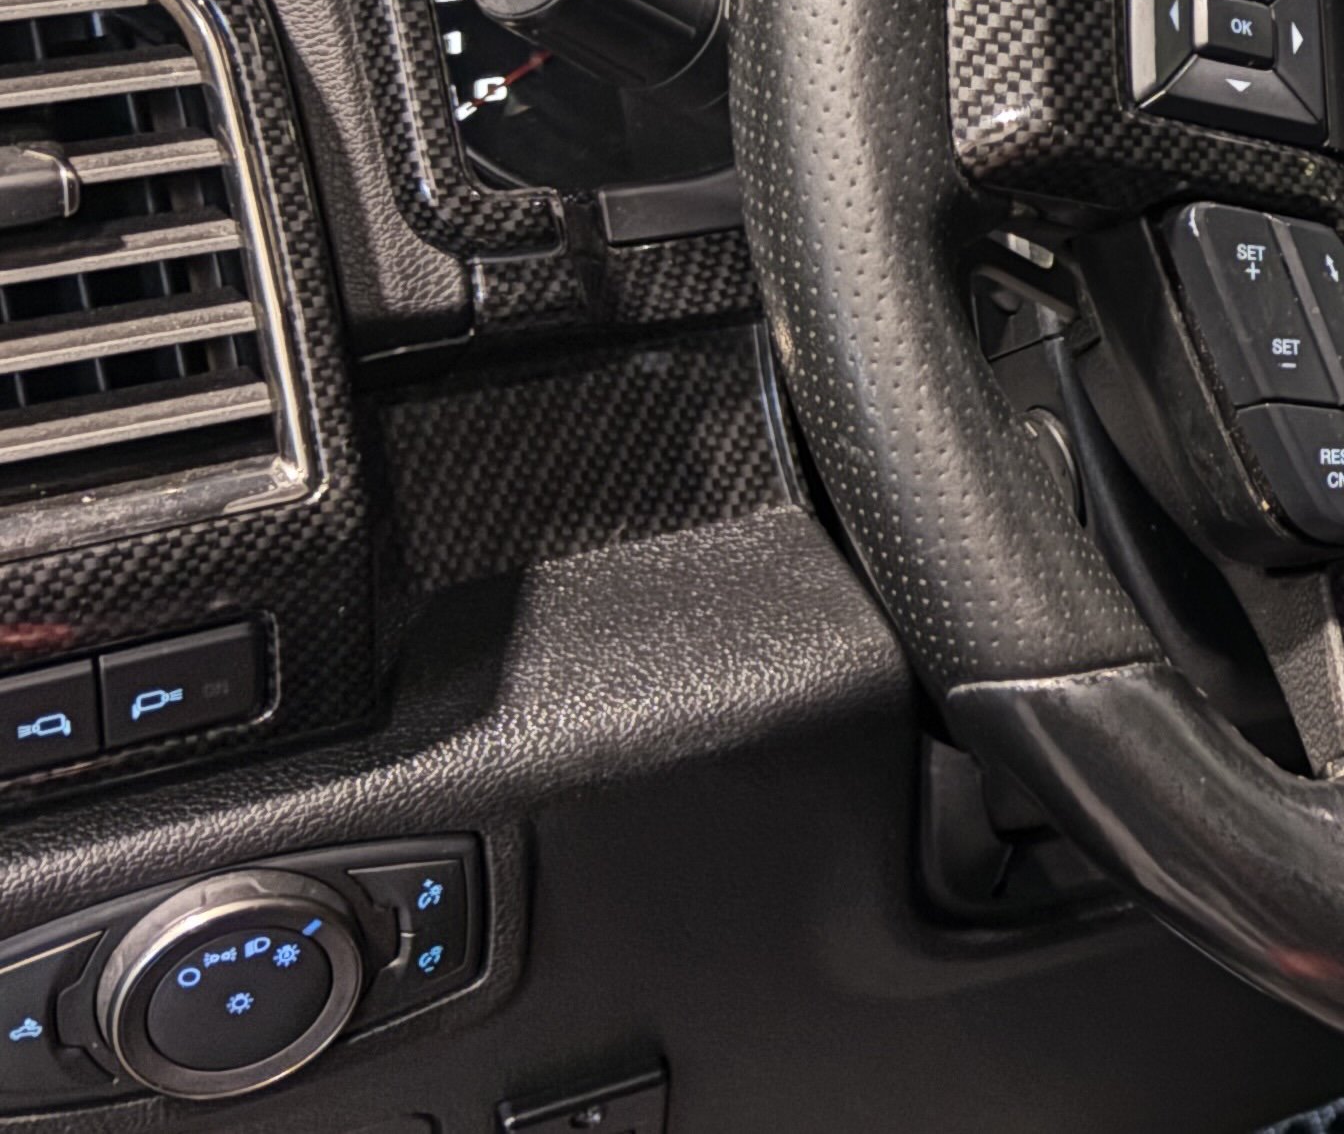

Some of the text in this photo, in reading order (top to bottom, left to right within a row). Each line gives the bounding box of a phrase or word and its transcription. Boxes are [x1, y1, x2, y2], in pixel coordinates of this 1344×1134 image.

[1231, 18, 1253, 36] OK
[444, 31, 463, 54] 1
[474, 77, 507, 101] 0
[1237, 244, 1265, 260] SET
[1272, 339, 1300, 355] SET
